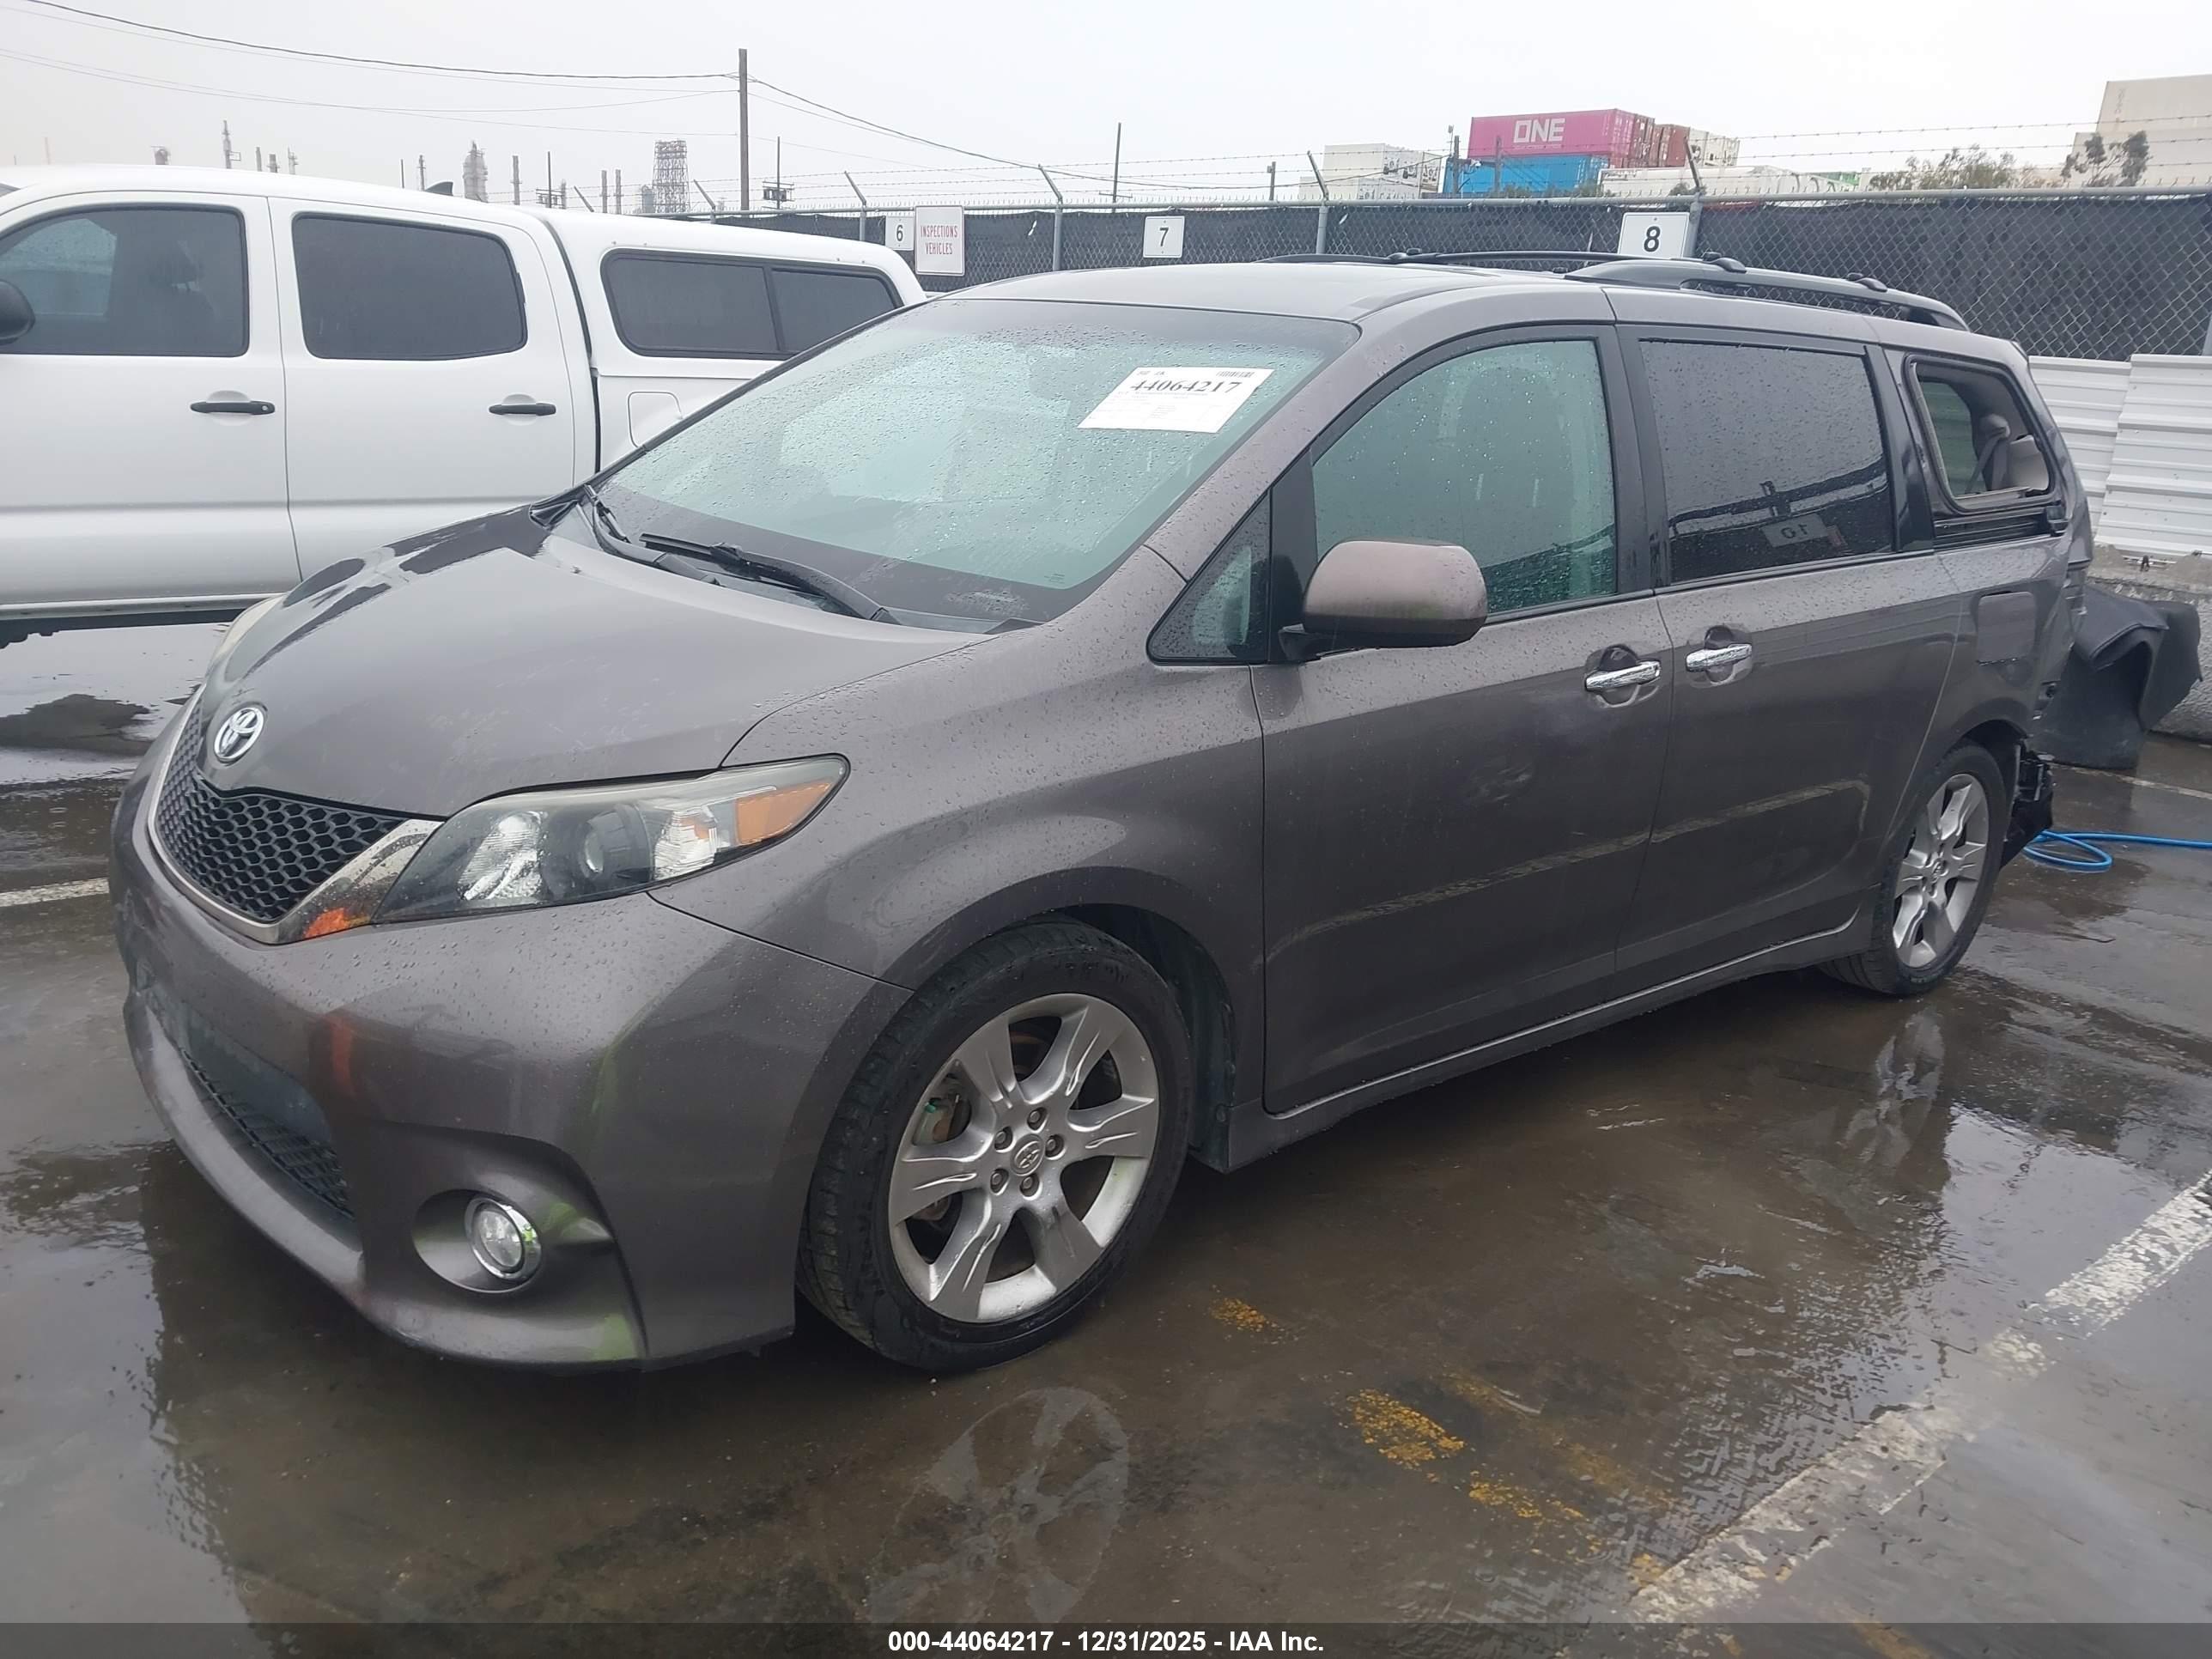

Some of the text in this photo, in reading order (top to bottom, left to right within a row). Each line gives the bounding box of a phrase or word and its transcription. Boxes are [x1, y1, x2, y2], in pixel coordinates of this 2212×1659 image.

[1513, 118, 1565, 143] ONE
[896, 224, 904, 242] 6
[920, 225, 958, 238] INSPECTIONS
[1158, 227, 1170, 247] 7
[1642, 225, 1662, 253] 8
[925, 241, 953, 255] VEHICLES
[1130, 380, 1243, 393] 44064217
